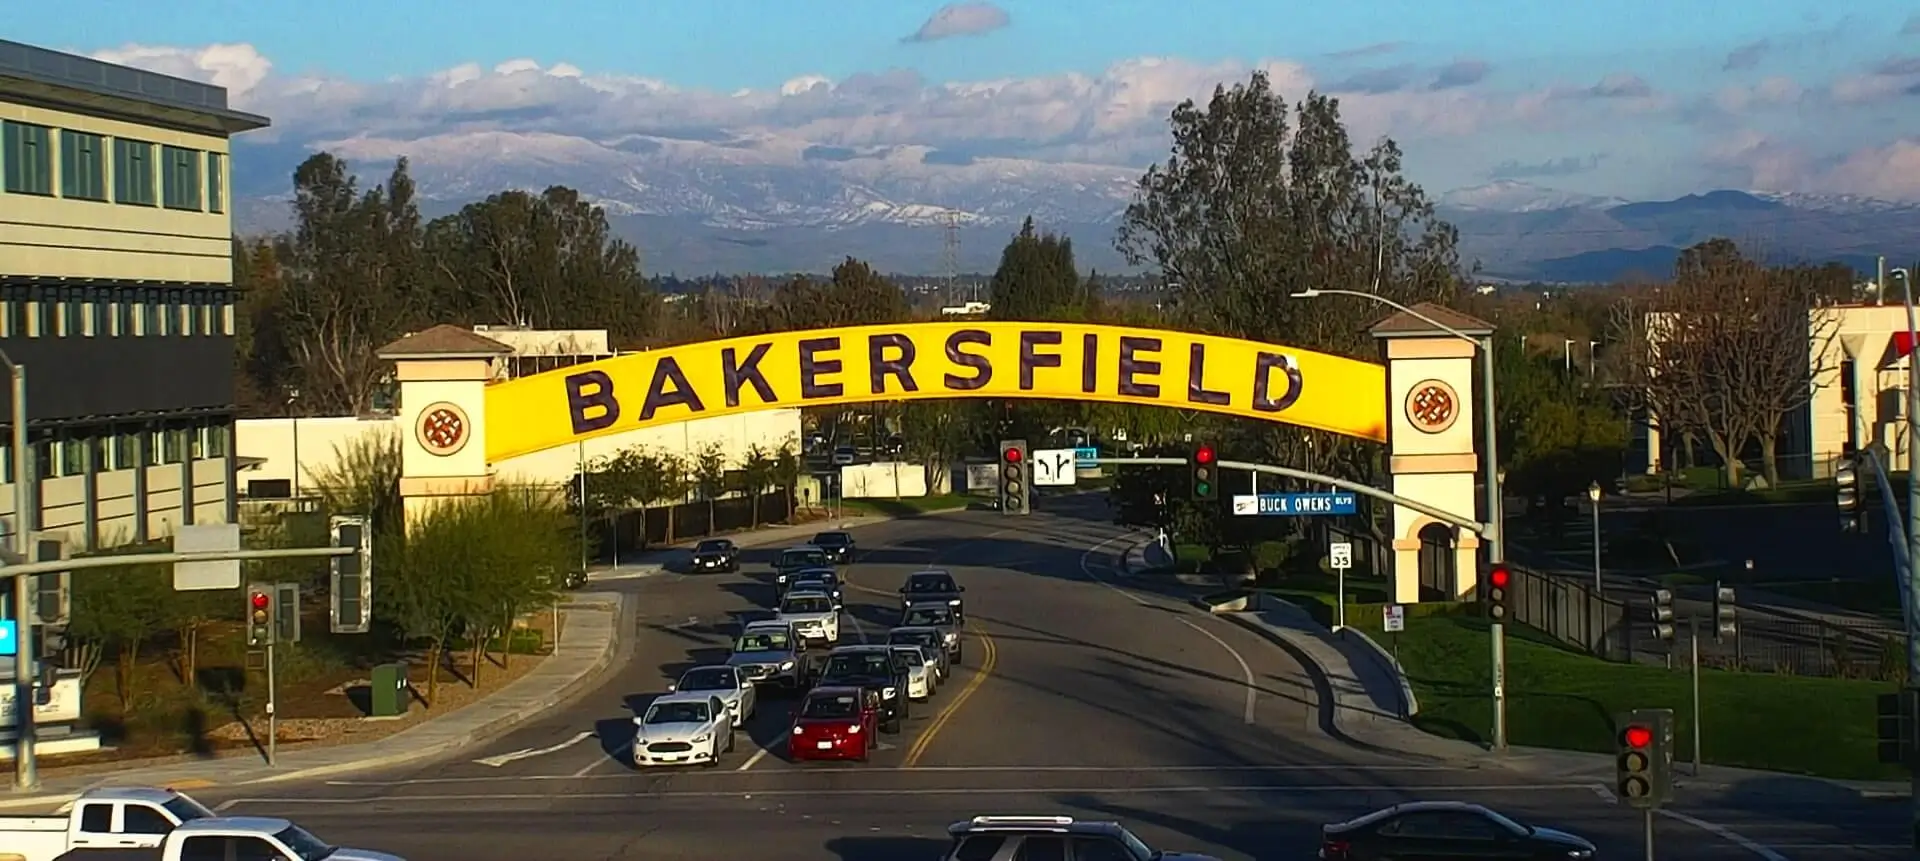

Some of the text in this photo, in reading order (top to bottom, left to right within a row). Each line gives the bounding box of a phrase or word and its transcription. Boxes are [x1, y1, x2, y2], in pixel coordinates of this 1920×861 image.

[565, 330, 1303, 434] BAKERSFIELD
[1260, 498, 1288, 512] BUCK
[1294, 497, 1331, 512] OWENS
[1333, 556, 1349, 566] 35
